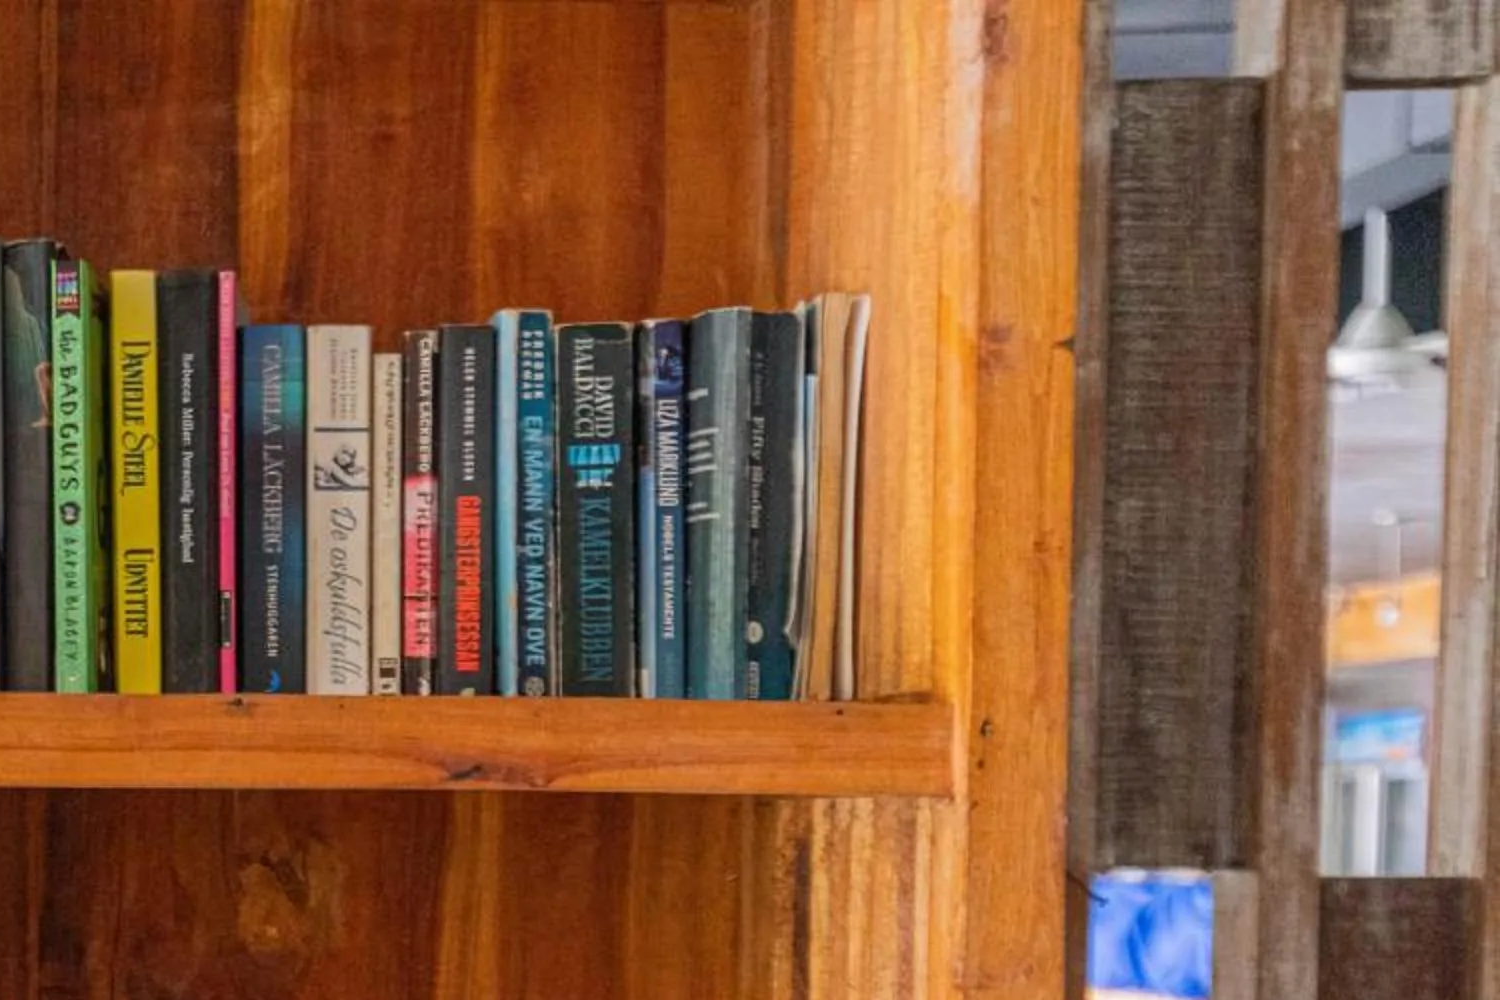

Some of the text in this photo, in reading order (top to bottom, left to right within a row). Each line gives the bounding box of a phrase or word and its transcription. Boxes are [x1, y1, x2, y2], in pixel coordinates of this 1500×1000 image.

[60, 329, 79, 492] the BAD GUYS
[119, 339, 157, 498] DANIELLE STEEL
[182, 353, 195, 404] Rebecca
[419, 337, 433, 399] CAMILLA
[572, 337, 595, 439] BALDACCI
[594, 375, 615, 438] DAVID
[261, 343, 286, 554] CAMILLA LÄCKBERG
[656, 398, 680, 507] LIZA MARKLUND
[329, 506, 358, 543] De
[523, 415, 546, 667] EN MANN VED NAVN OVE
[123, 547, 155, 640] UDNYTTET
[455, 495, 481, 673] GANGSTERPRINSESSAN
[579, 497, 613, 683] KAMELKLUBBEN
